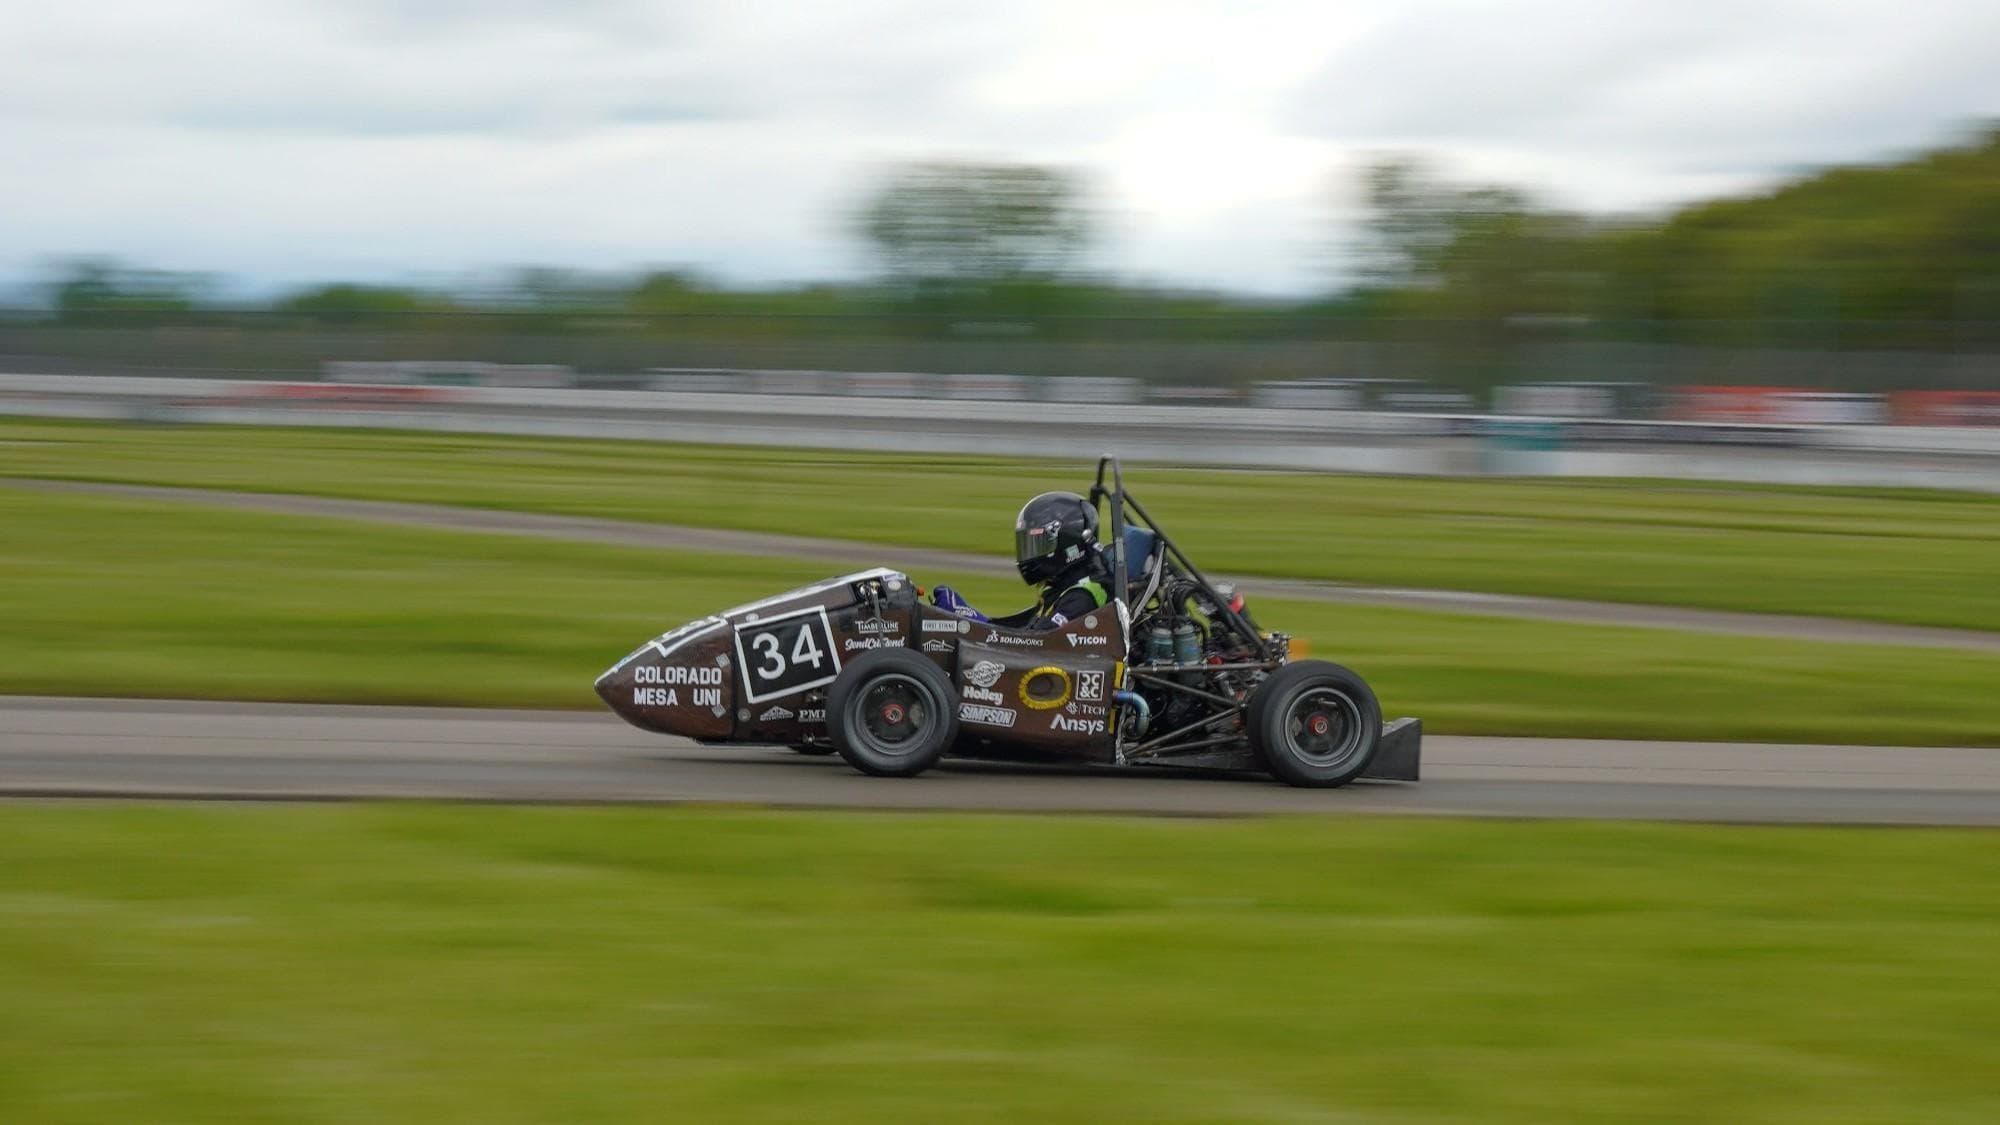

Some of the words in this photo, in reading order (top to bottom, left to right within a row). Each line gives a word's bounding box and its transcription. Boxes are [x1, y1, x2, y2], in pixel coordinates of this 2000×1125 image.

[845, 636, 905, 651] SendCuSend
[1000, 636, 1044, 647] SOLIDWORKS
[1077, 636, 1107, 645] TICON
[752, 623, 823, 680] 34
[634, 666, 722, 684] COLORADO
[634, 688, 678, 706] MESA
[693, 689, 721, 706] UNI
[963, 685, 1004, 706] Holley
[960, 706, 1013, 724] SIMPSON
[1050, 713, 1105, 736] Ansys
